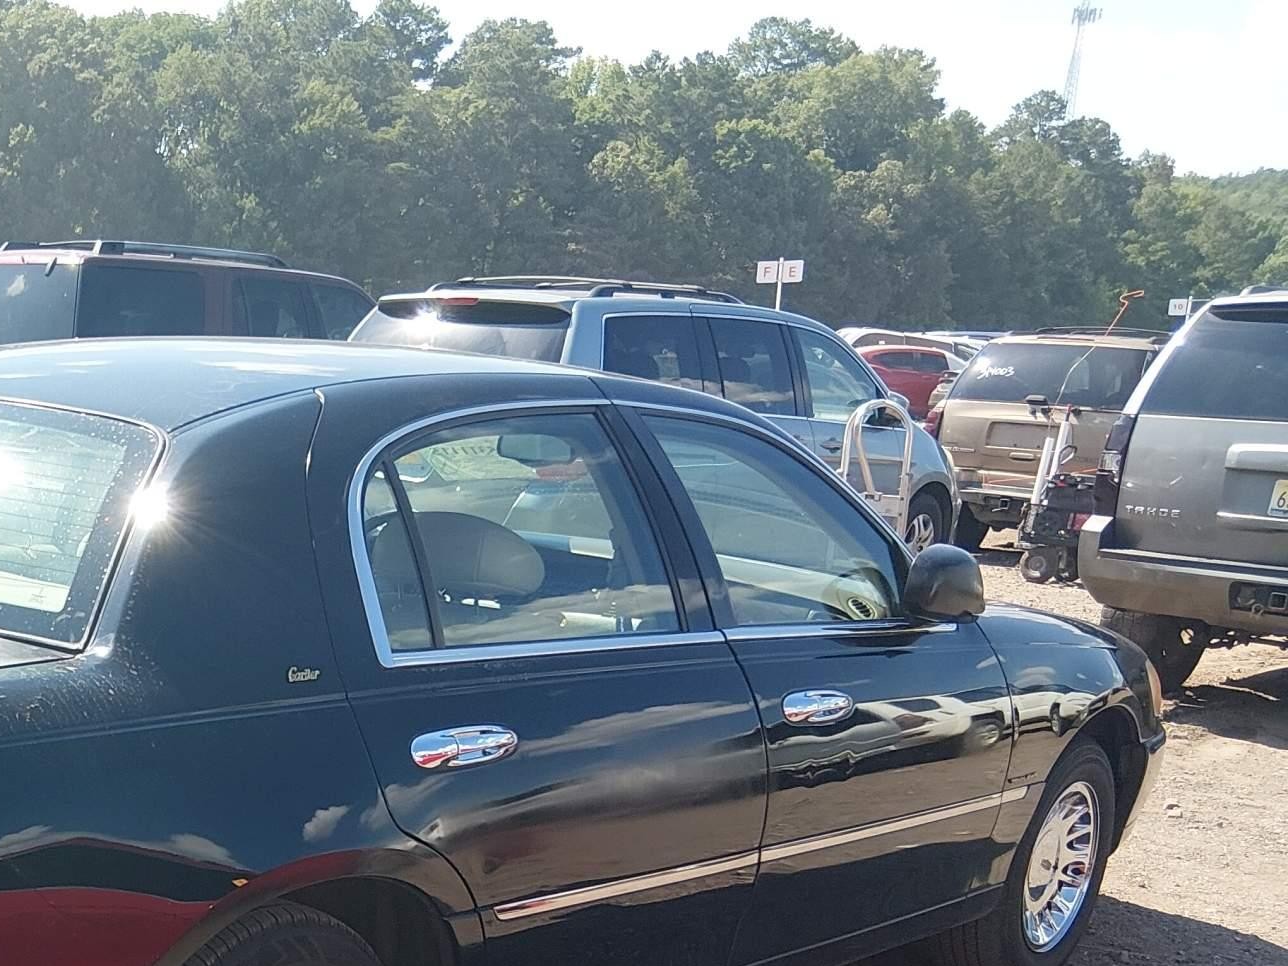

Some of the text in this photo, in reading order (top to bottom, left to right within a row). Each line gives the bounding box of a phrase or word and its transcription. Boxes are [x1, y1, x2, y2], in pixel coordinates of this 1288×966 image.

[763, 266, 772, 278] F
[788, 266, 797, 278] E
[1125, 504, 1181, 518] TAHOE
